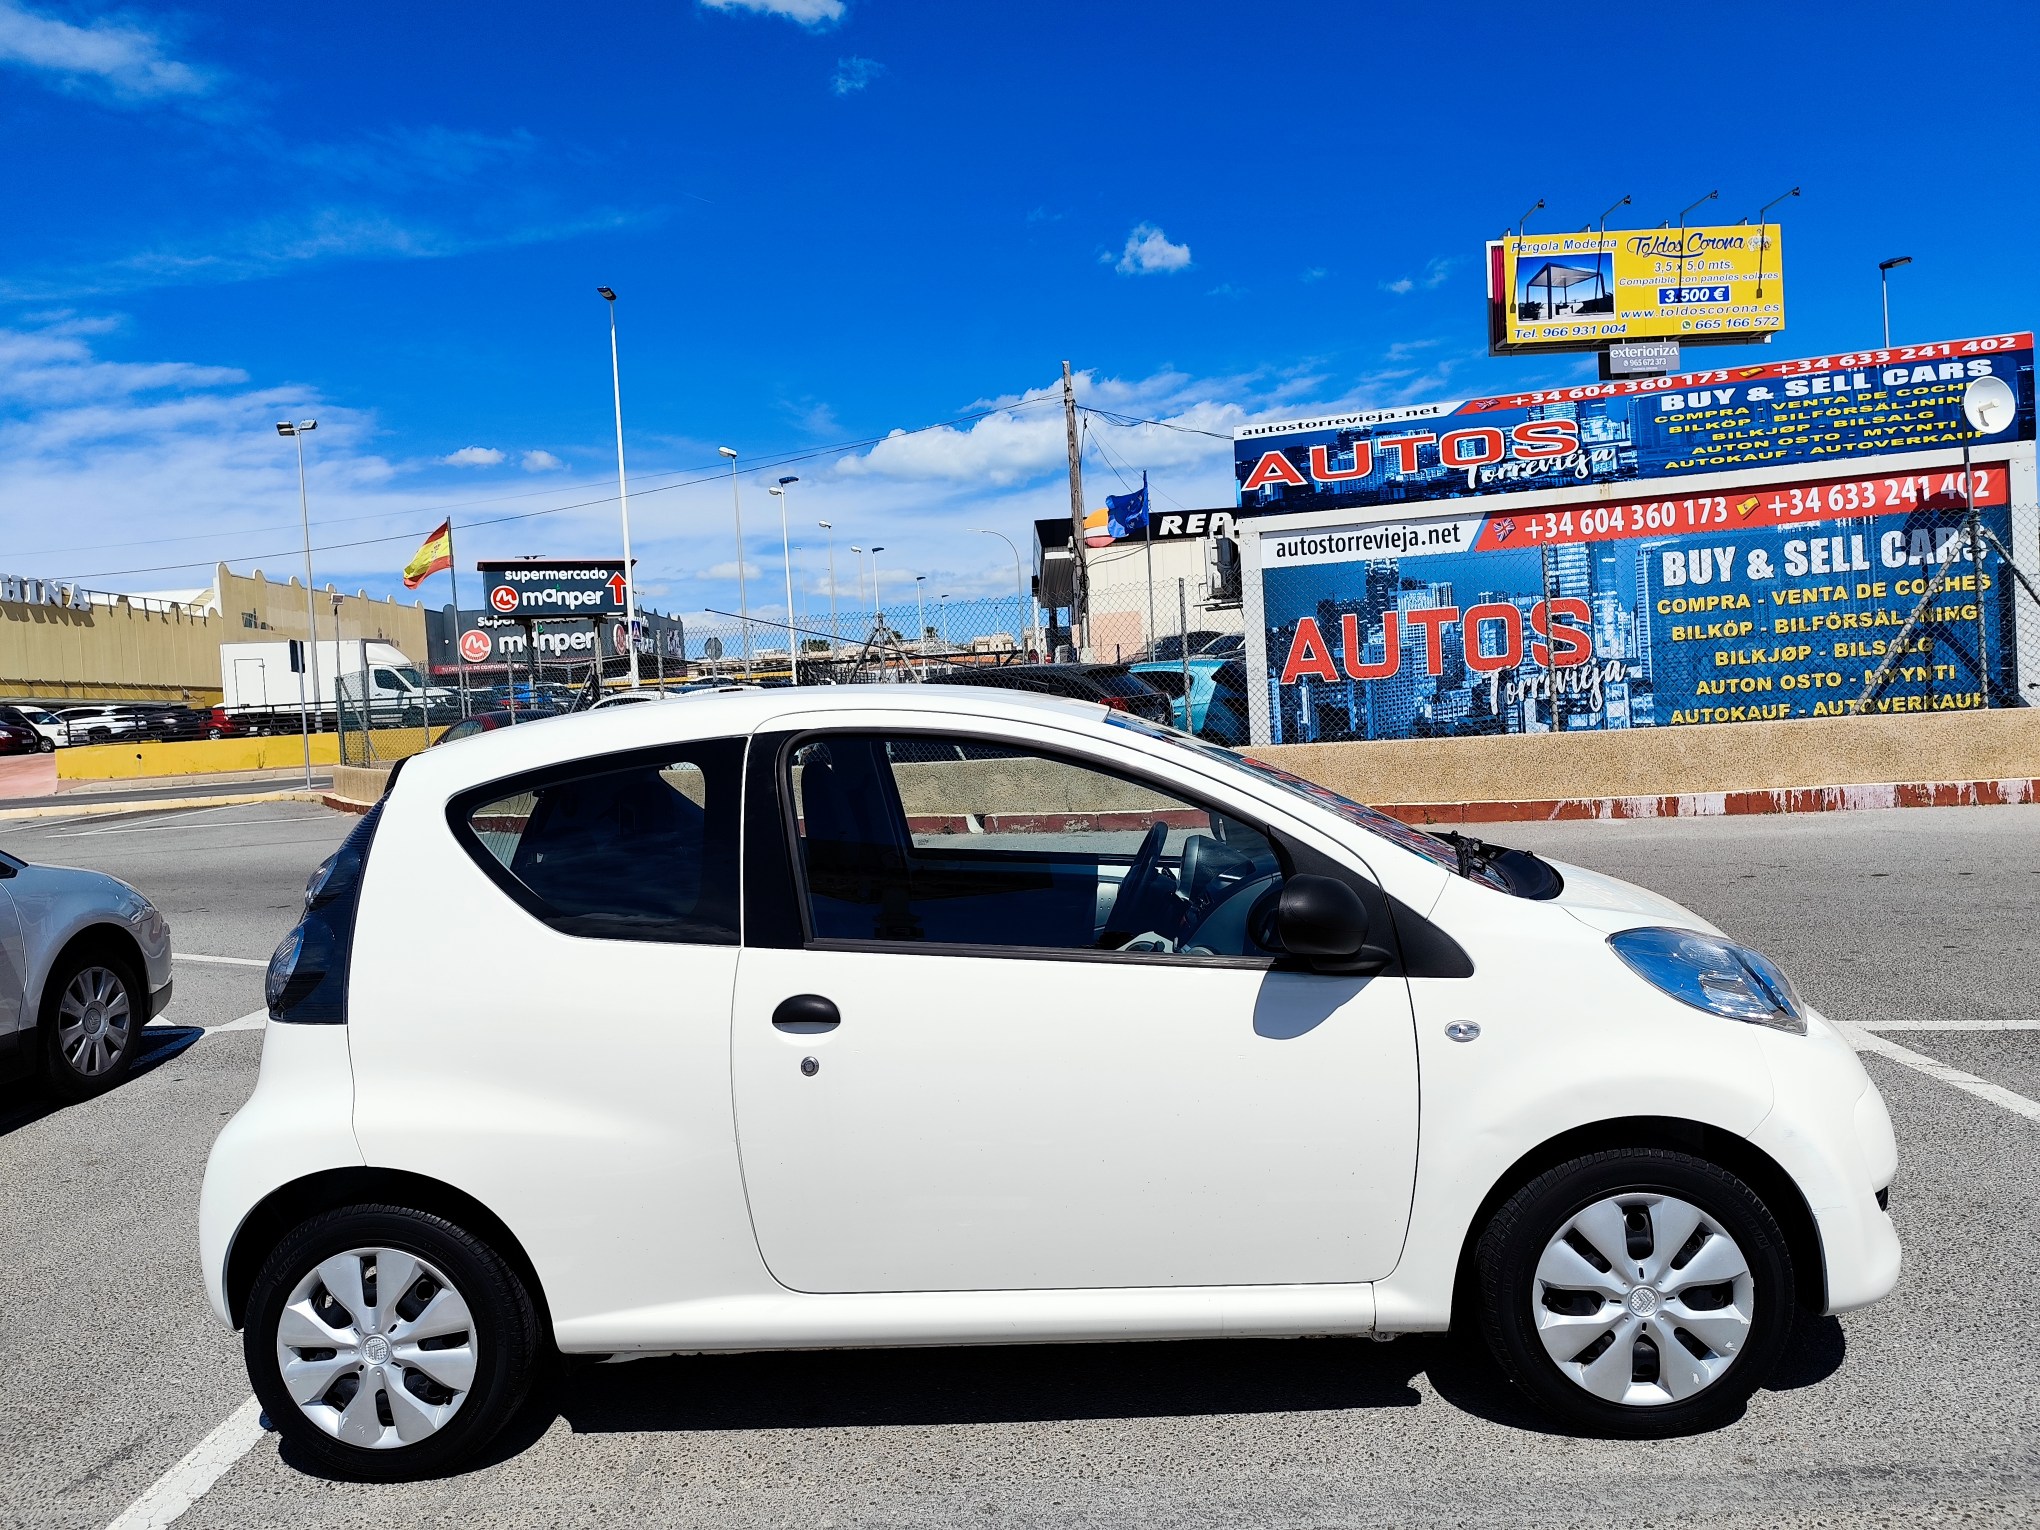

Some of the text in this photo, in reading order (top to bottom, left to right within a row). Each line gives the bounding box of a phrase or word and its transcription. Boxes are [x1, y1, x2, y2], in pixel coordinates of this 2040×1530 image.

[1512, 239, 1618, 253] Pérgola Moderna
[1687, 232, 1745, 252] Corona
[1619, 276, 1676, 286] Compatible
[1700, 274, 1739, 284] paneles
[1742, 272, 1779, 280] solares
[1654, 262, 1672, 272] 3,5
[1686, 260, 1705, 272] 5,0
[1708, 260, 1734, 270] mts.
[1664, 288, 1726, 303] 3.500 €
[1620, 304, 1780, 319] www.toldoscorona.es
[1695, 316, 1780, 329] 665 166 572
[1514, 324, 1626, 339] Tel. 966 931 004
[1610, 344, 1678, 358] exterioriza
[1242, 336, 2017, 436] autostorrevieja.net +34 604 360 173 +34 633 241 402
[1660, 358, 1993, 412] BUY & SELL CARS
[1654, 406, 1749, 423] COMPRA
[1770, 394, 1849, 412] VENTA
[1858, 390, 1889, 402] DE
[1896, 382, 1972, 397] COCH
[1668, 416, 1751, 434] BILKÖP
[1773, 396, 1960, 423] BILFÖRSÄLJNIN
[1691, 438, 1770, 456] AUTON
[1777, 432, 1841, 446] OSTO
[1862, 420, 1958, 438] MYYNTI
[1712, 423, 1811, 442] BILKJØP
[1833, 410, 1935, 429] BILSALG
[1241, 418, 1583, 493] AUTOS
[1664, 449, 1788, 470] AUTOKAUF
[1809, 430, 1986, 456] AUTOVERKAUF
[1459, 449, 1615, 490] Torrevieja
[1158, 512, 1238, 536] REP
[1276, 470, 1990, 559] autostorrevieja.net +34 604 360 173 +34 633 241 402
[1662, 546, 1736, 587] BUY
[1746, 548, 1774, 580] &
[1784, 534, 1870, 577] SELL
[504, 567, 608, 583] supermercado
[522, 588, 604, 610] manper
[1656, 594, 1751, 615] COMPRA
[1772, 585, 1848, 606] VENTA
[1856, 581, 1886, 599] DE
[1671, 618, 1753, 642] BILKÖP
[1774, 604, 1978, 634] BILFÖRSÄLNING
[1280, 596, 1594, 686] AUTOS
[1714, 644, 1812, 667] BILKJØP
[1482, 658, 1627, 715] Torrvieja
[1695, 675, 1773, 695] AUTON
[1780, 671, 1842, 690] OSTO
[1670, 705, 1790, 725] AUTOKAUF
